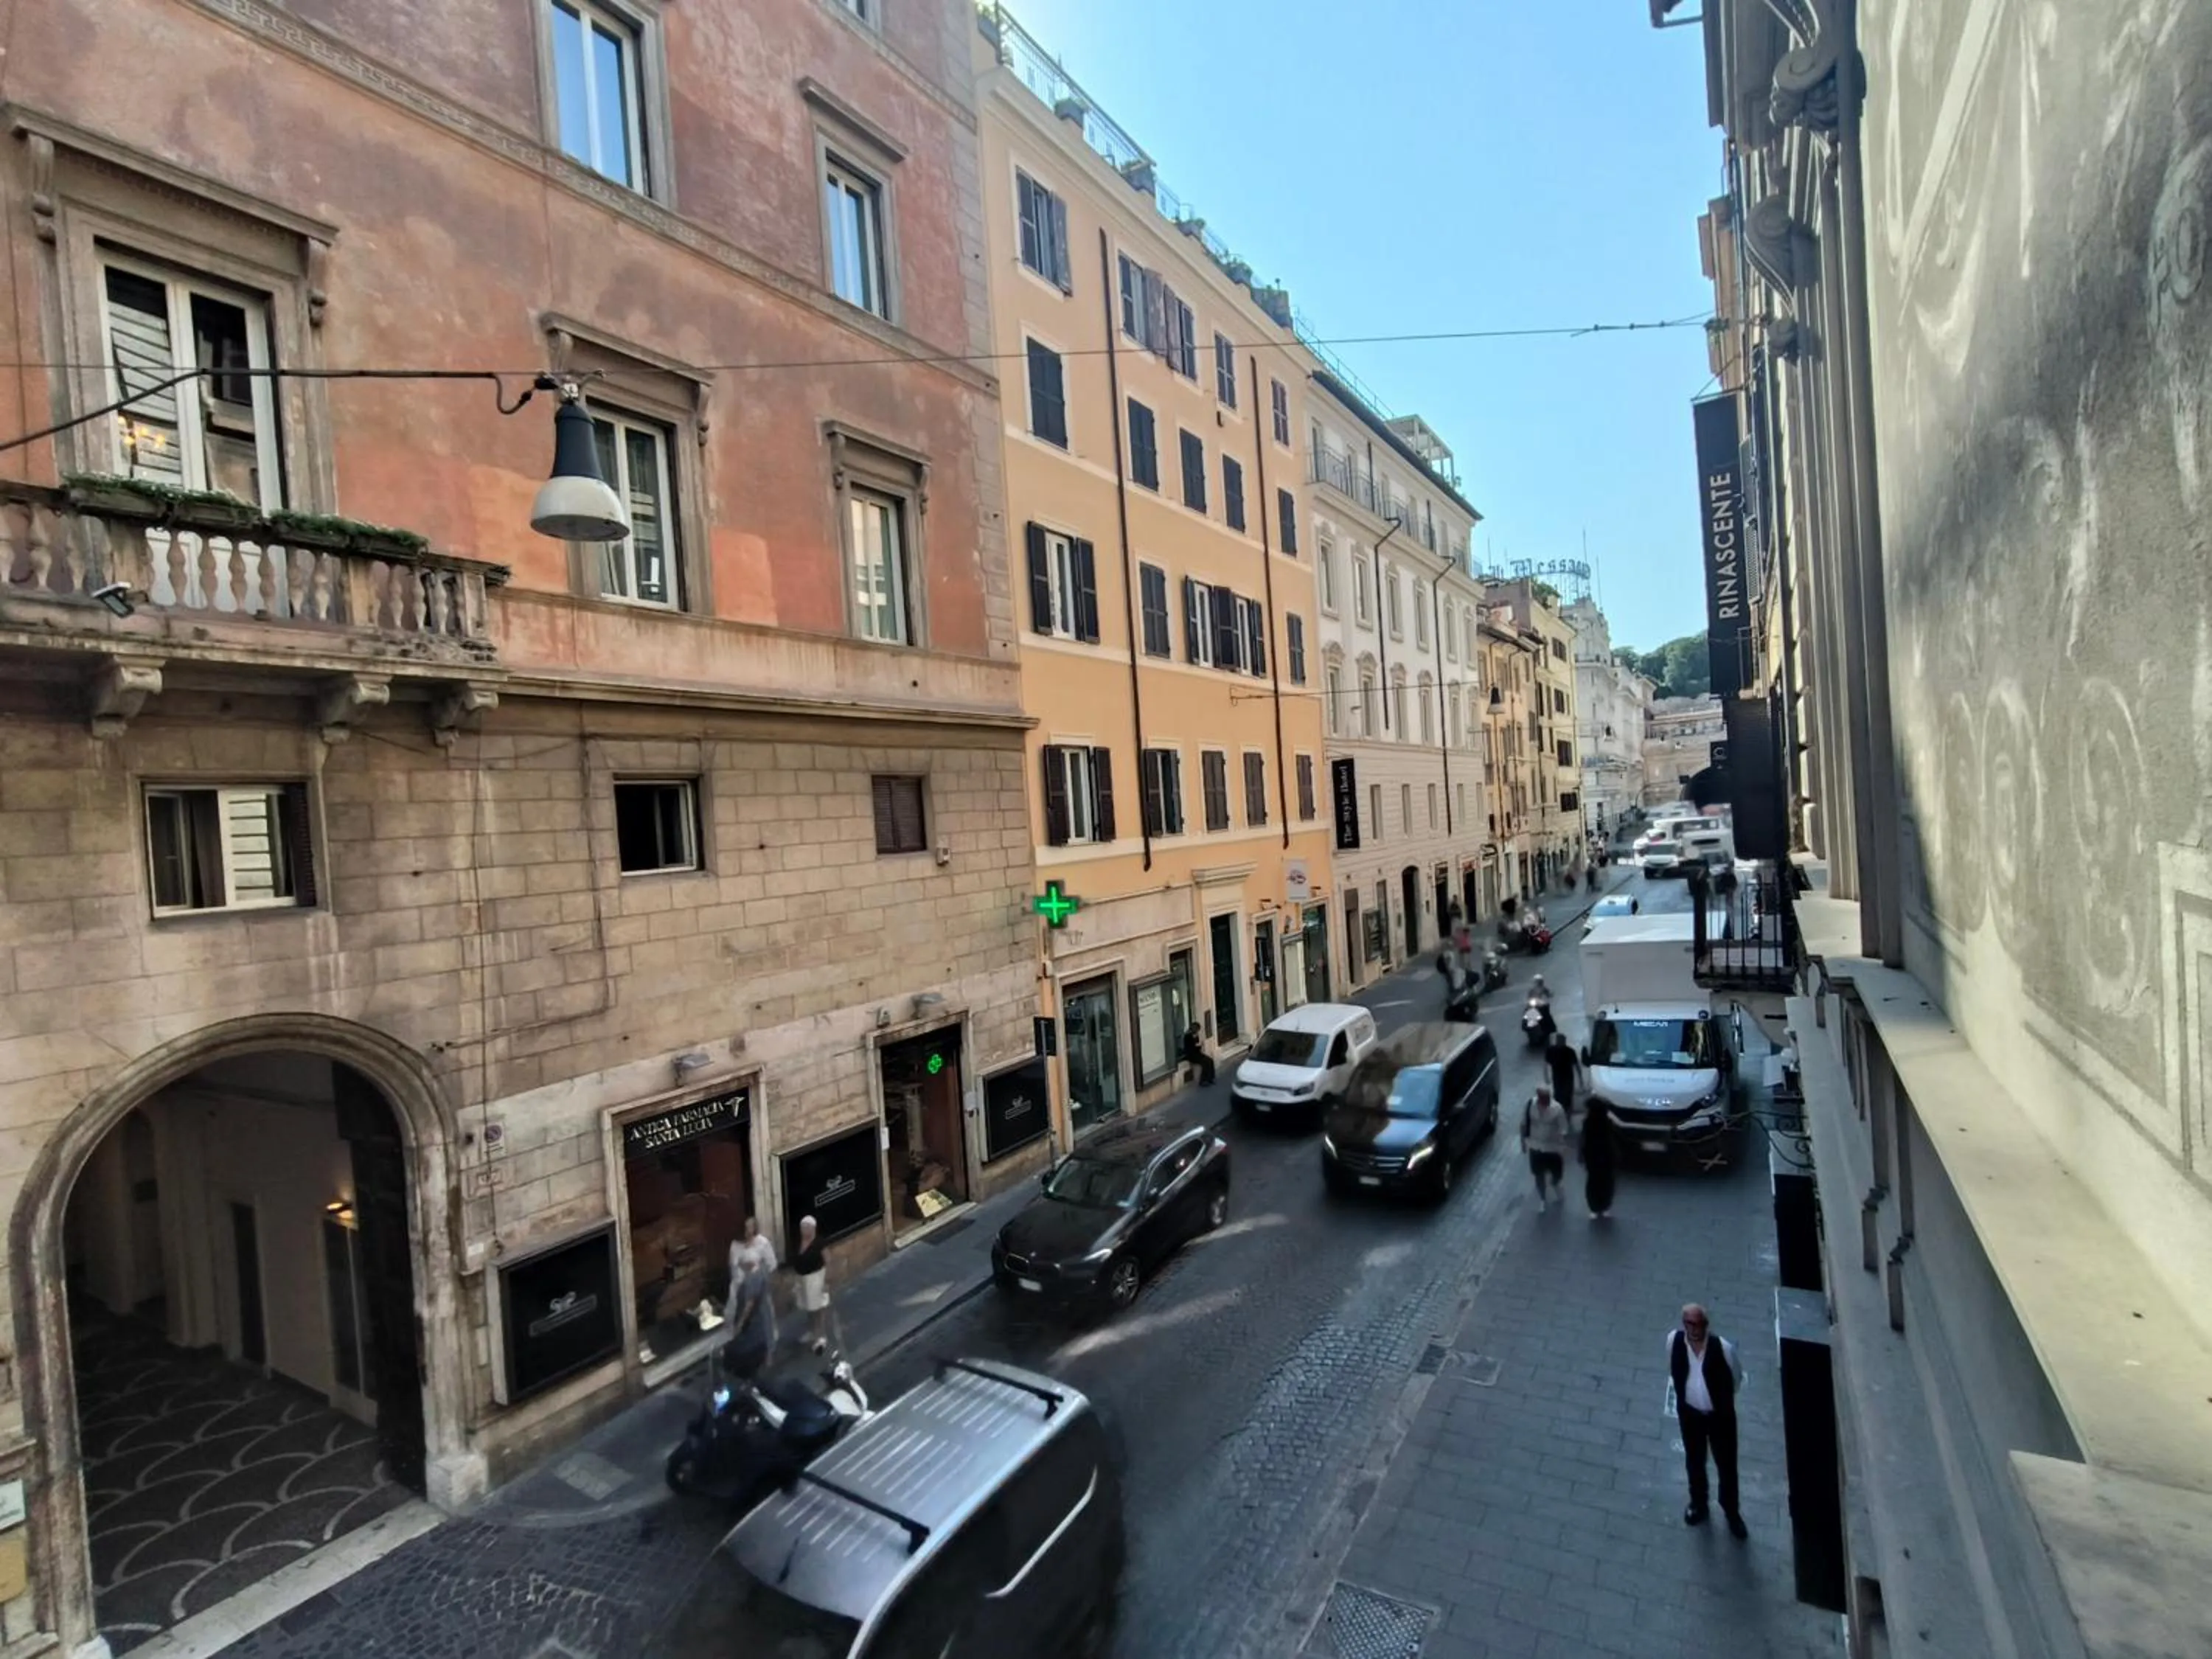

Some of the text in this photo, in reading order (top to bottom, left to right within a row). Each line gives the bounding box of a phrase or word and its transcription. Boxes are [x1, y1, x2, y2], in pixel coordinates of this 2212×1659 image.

[1710, 472, 1740, 619] RINASCENTE
[630, 1101, 724, 1141] ANTICA FARMACIA
[645, 1117, 713, 1149] SANTA LUCIA
